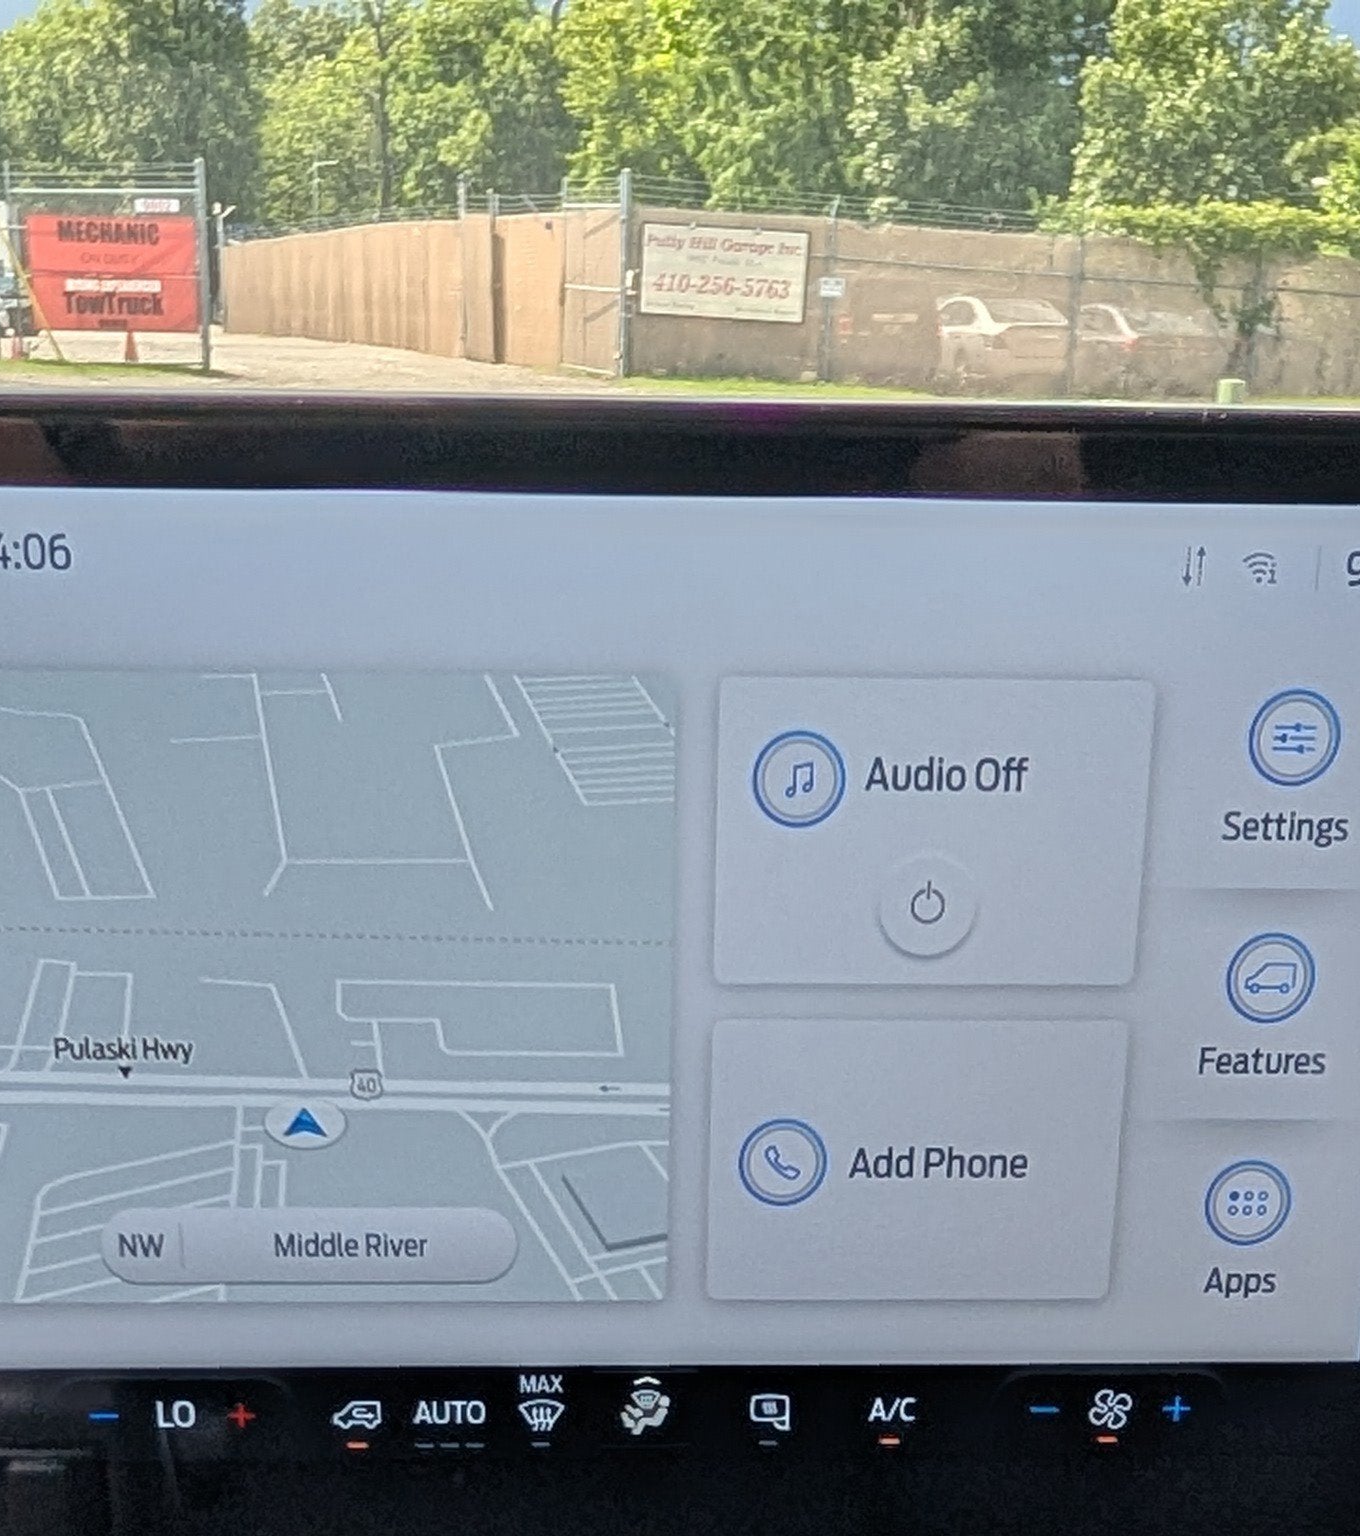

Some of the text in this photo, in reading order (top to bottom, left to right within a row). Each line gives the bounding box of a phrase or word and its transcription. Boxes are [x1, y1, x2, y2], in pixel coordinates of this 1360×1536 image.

[57, 220, 160, 246] MECHANIC
[865, 756, 1030, 793] Audio Off
[1221, 811, 1350, 847] Settings
[53, 1036, 194, 1065] Pulaski Hwy
[1198, 1047, 1327, 1076] Features
[356, 1076, 379, 1095] 40
[848, 1147, 1029, 1180] Add Phone
[118, 1232, 428, 1258] NW Middle River
[1203, 1267, 1277, 1298] Apps
[518, 1374, 564, 1395] MAX
[155, 1397, 917, 1429] LO AUTO A/C
